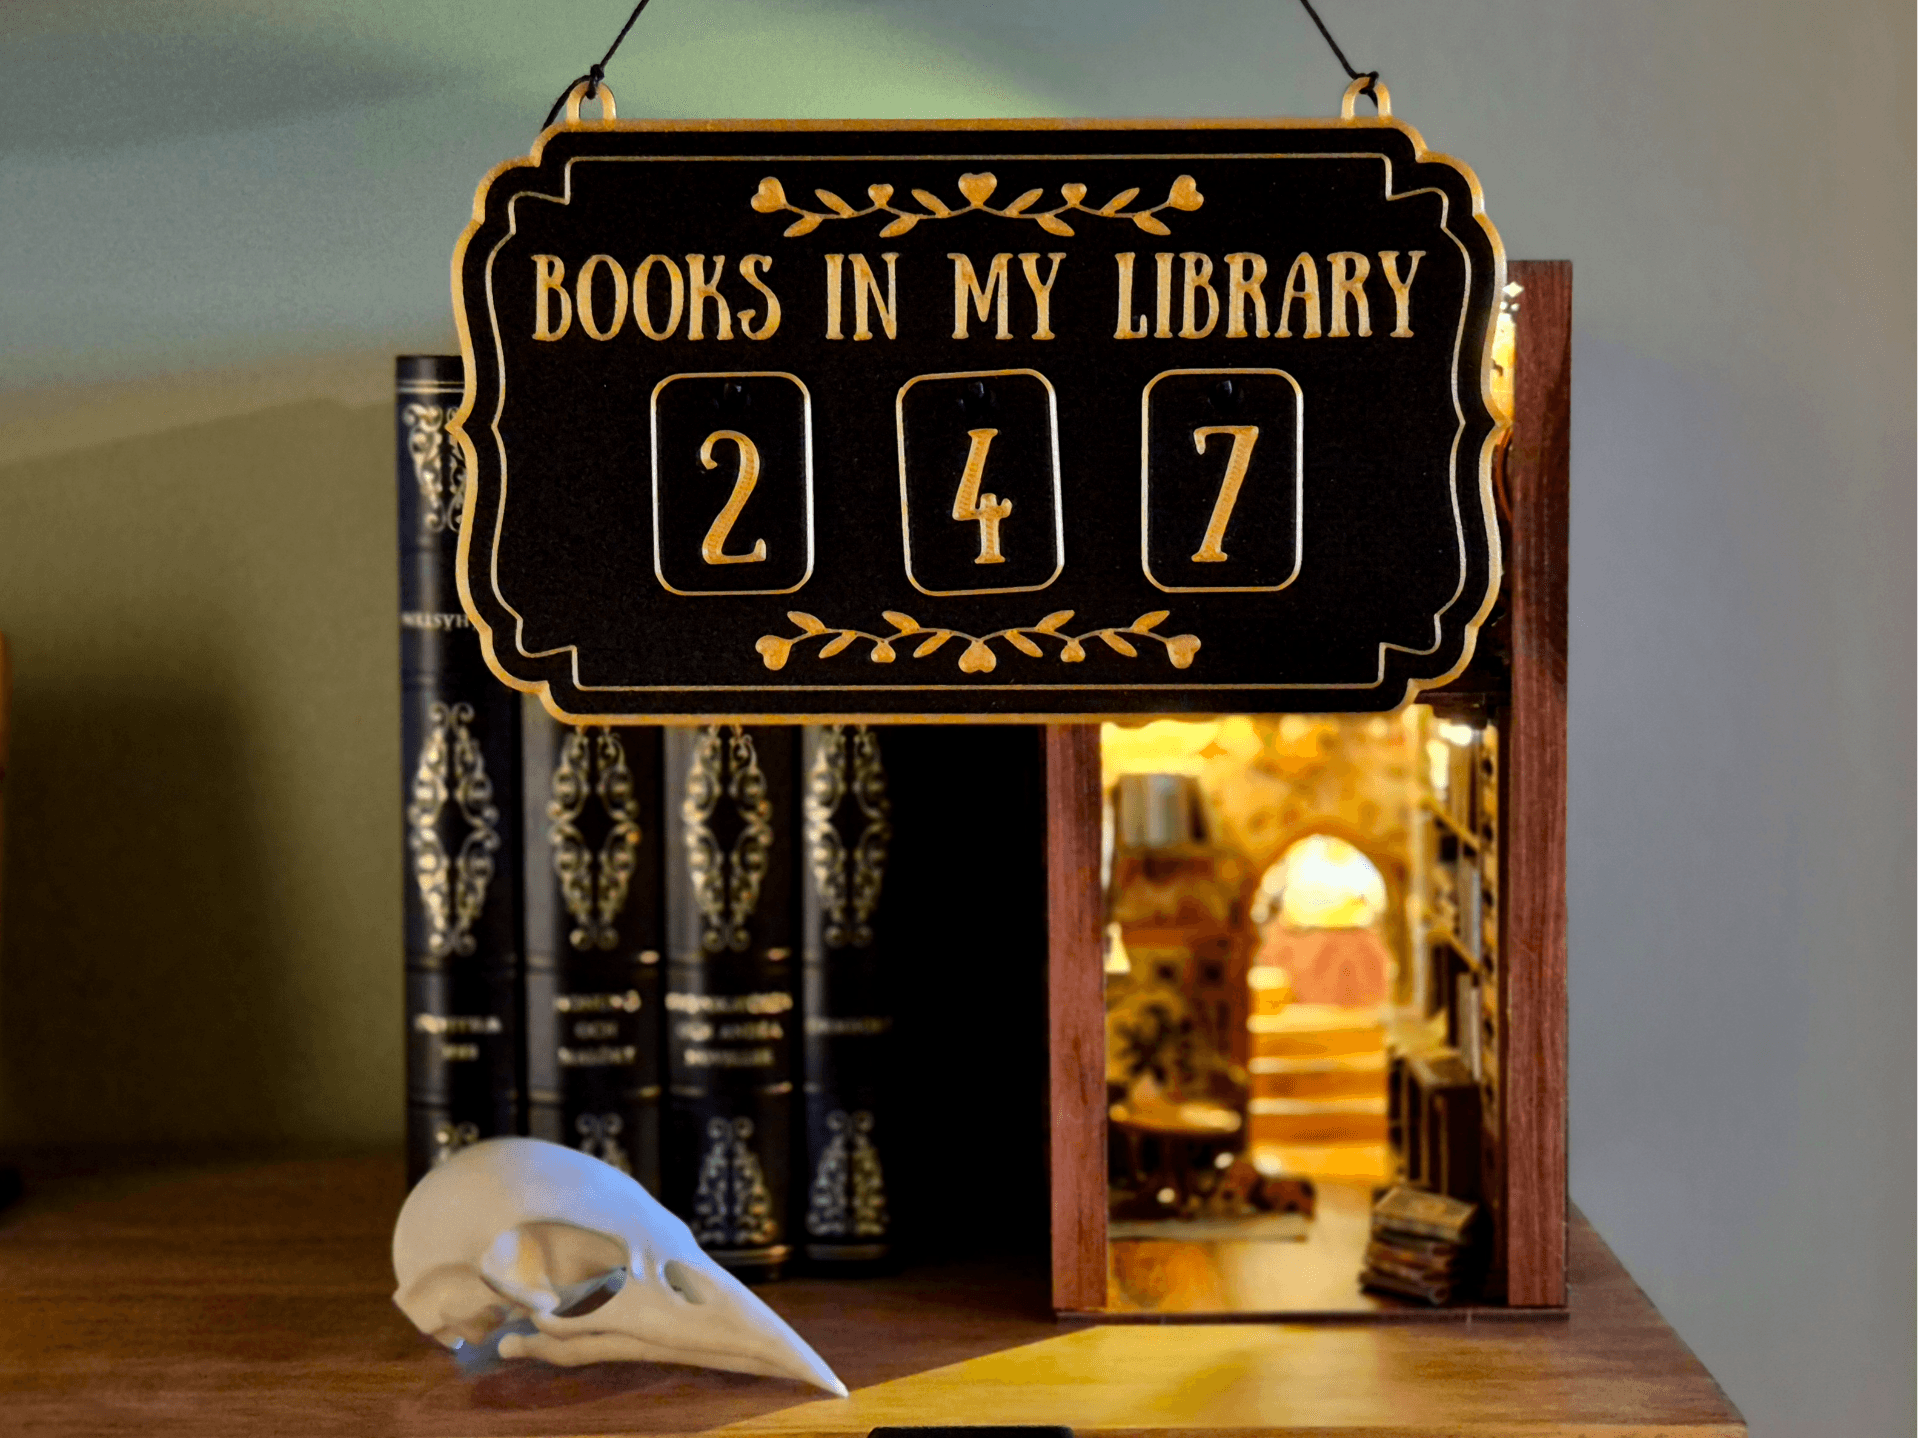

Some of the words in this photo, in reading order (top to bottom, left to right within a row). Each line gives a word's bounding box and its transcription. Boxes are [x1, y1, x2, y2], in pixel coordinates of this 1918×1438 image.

[532, 253, 782, 342] BOOKS
[825, 252, 900, 342] IN
[947, 252, 1067, 341] MY
[1113, 250, 1426, 340] LIBRARY
[699, 429, 767, 565] 2
[951, 428, 1013, 565] 4
[1191, 425, 1260, 563] 7
